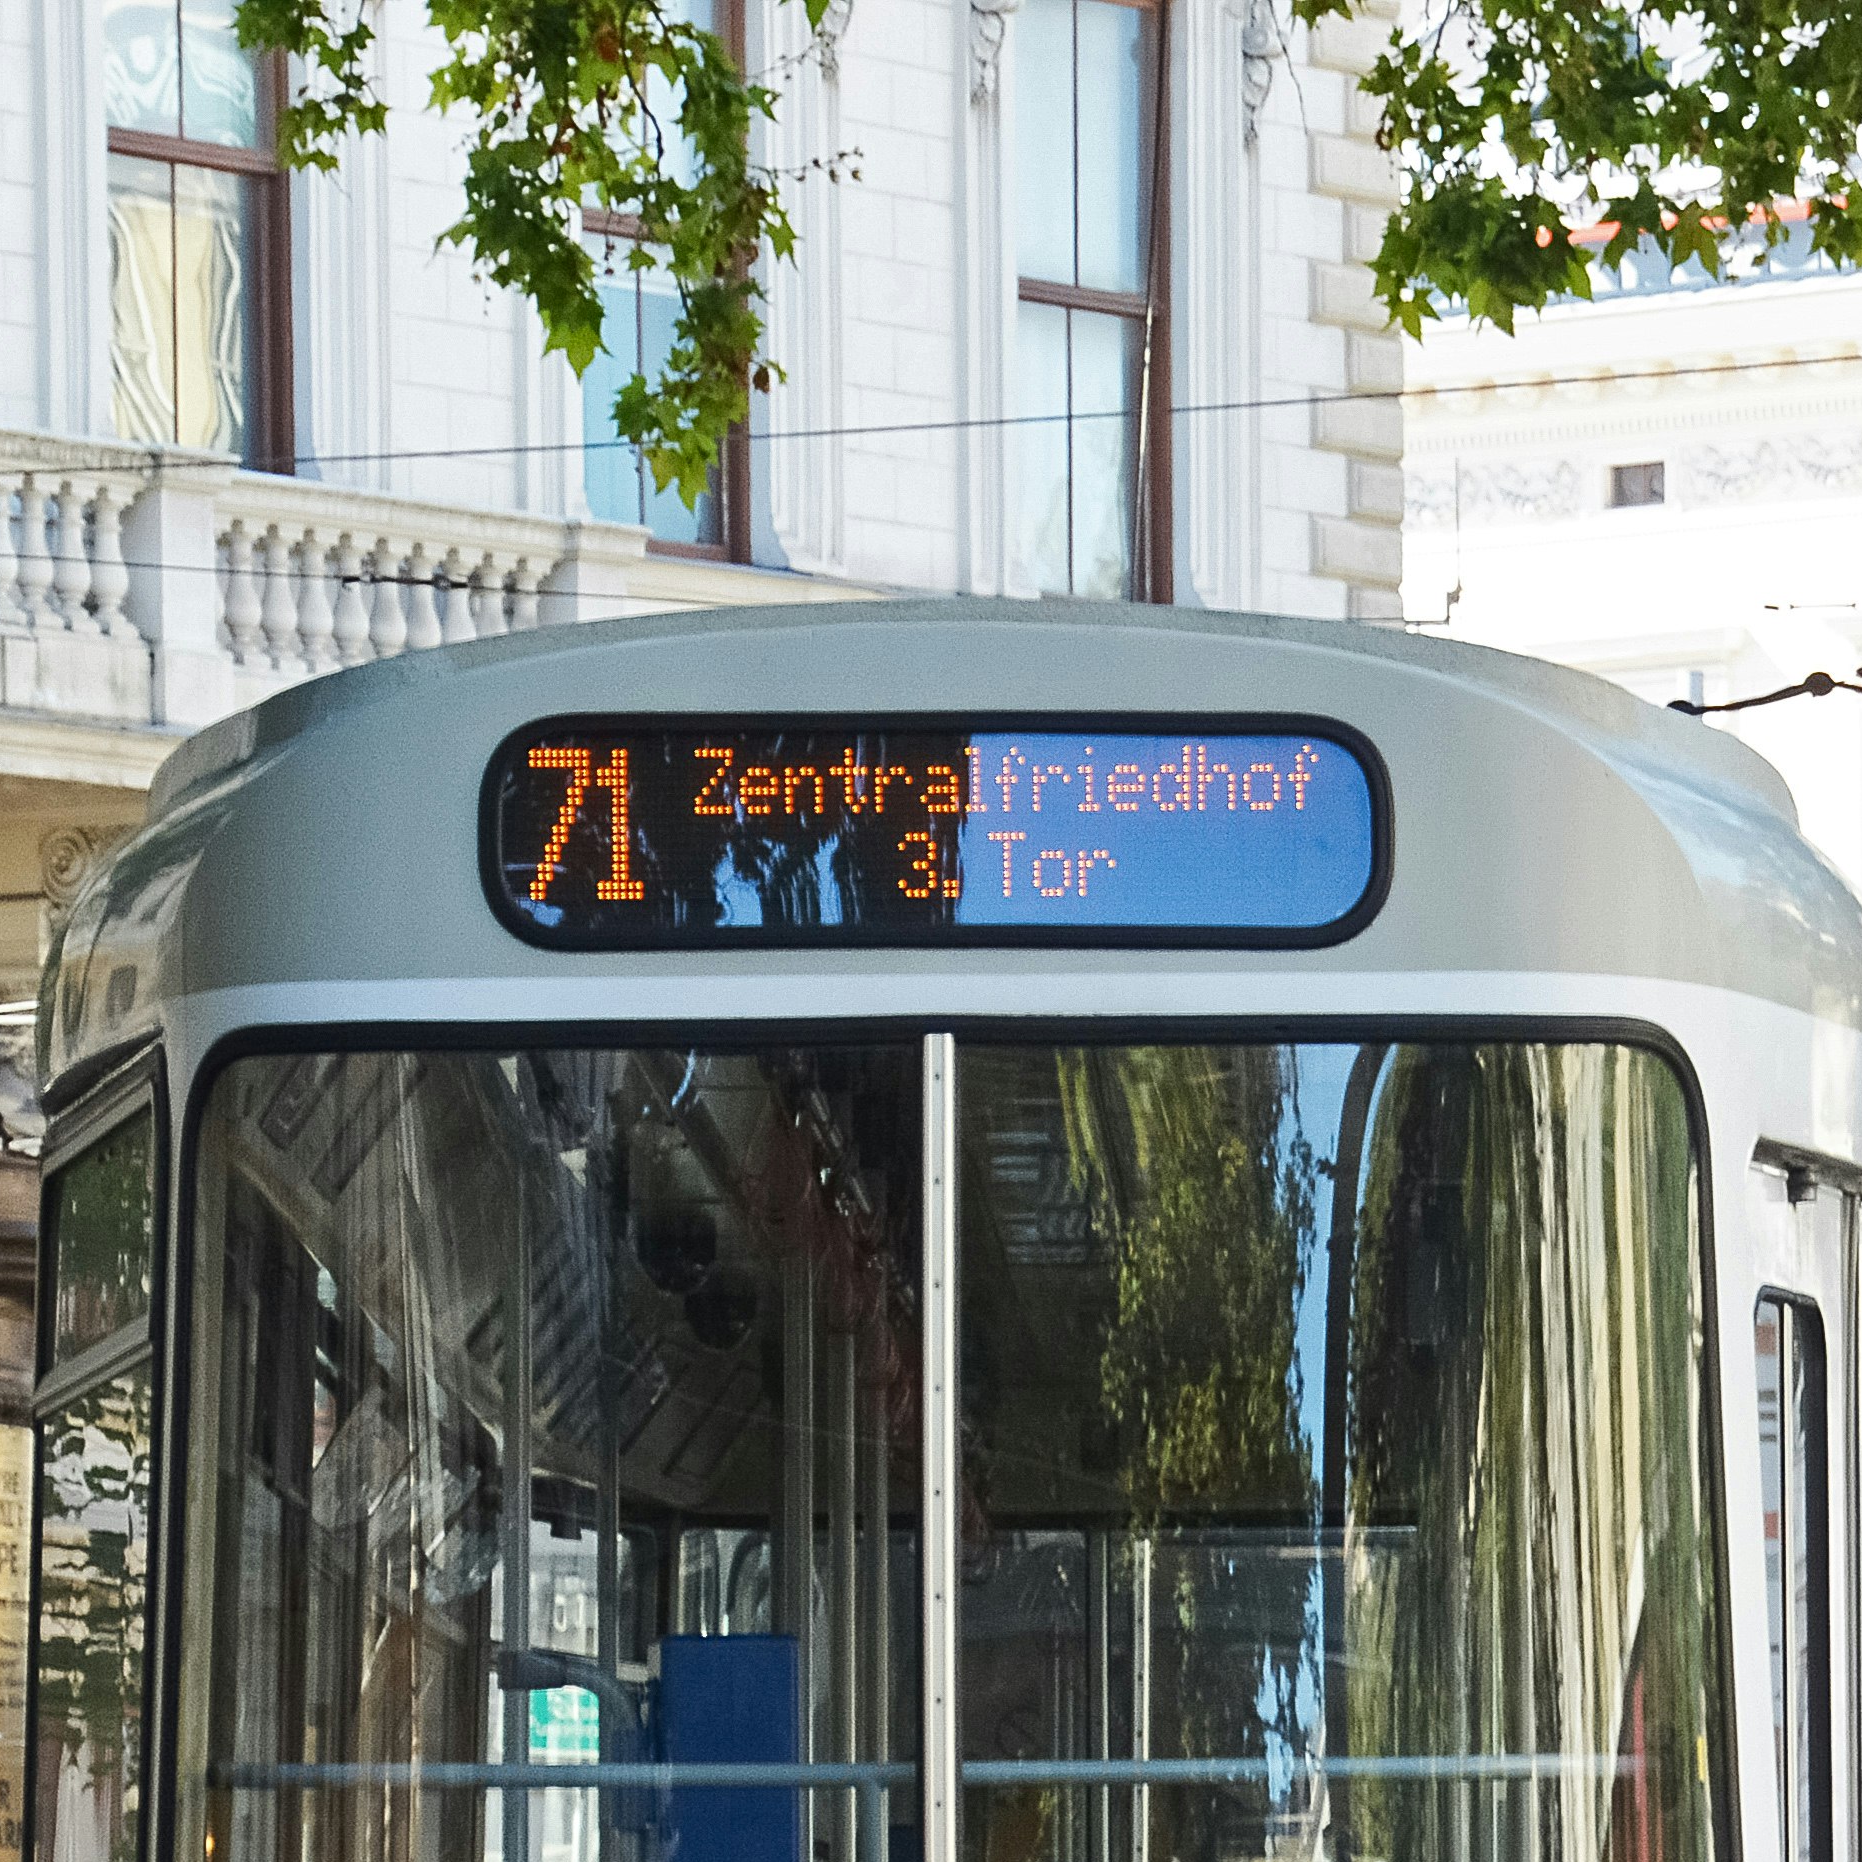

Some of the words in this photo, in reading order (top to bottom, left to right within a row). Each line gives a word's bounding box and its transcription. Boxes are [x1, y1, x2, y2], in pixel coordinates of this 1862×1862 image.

[527, 747, 645, 902] 71
[693, 744, 1321, 816] Zentralfriedhof
[896, 831, 959, 899] 3.
[986, 831, 1118, 898] Tor
